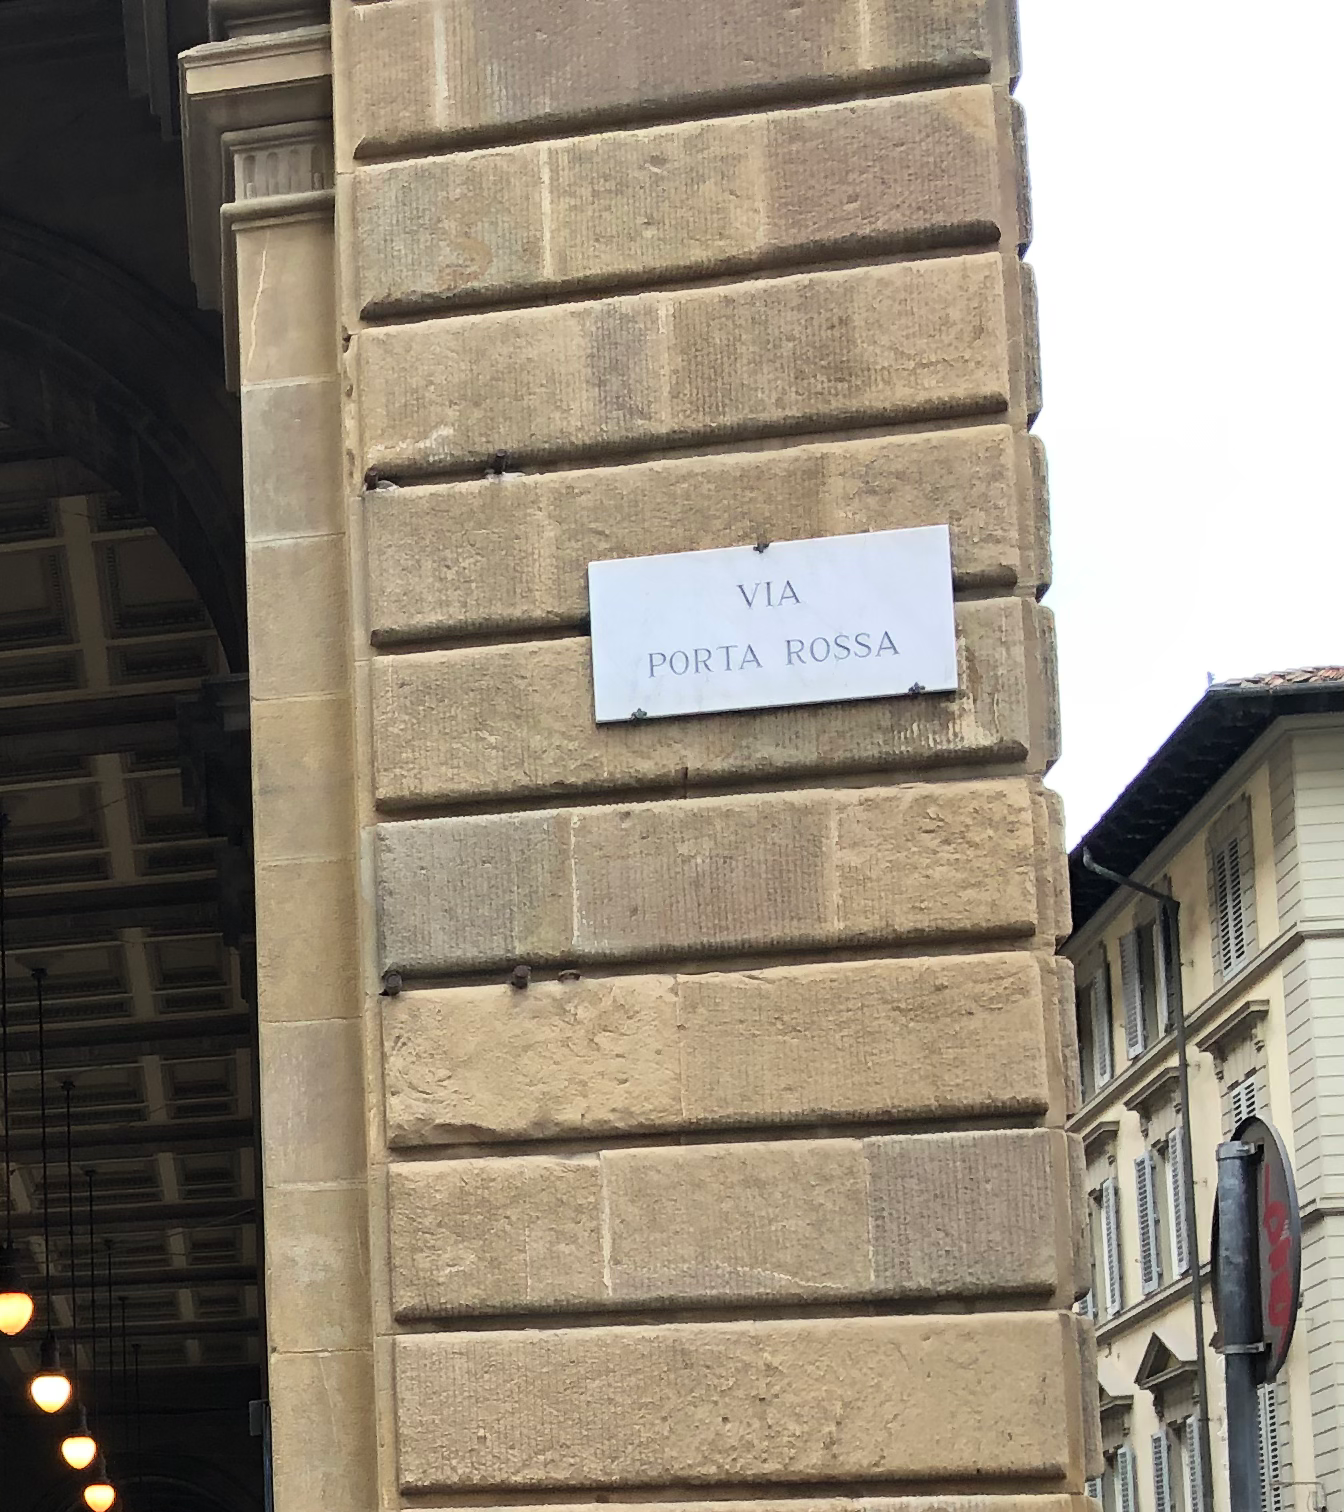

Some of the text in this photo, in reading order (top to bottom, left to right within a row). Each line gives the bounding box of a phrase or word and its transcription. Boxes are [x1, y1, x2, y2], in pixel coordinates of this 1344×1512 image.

[737, 580, 801, 609] VIA
[648, 631, 901, 678] PORTA ROSSA
